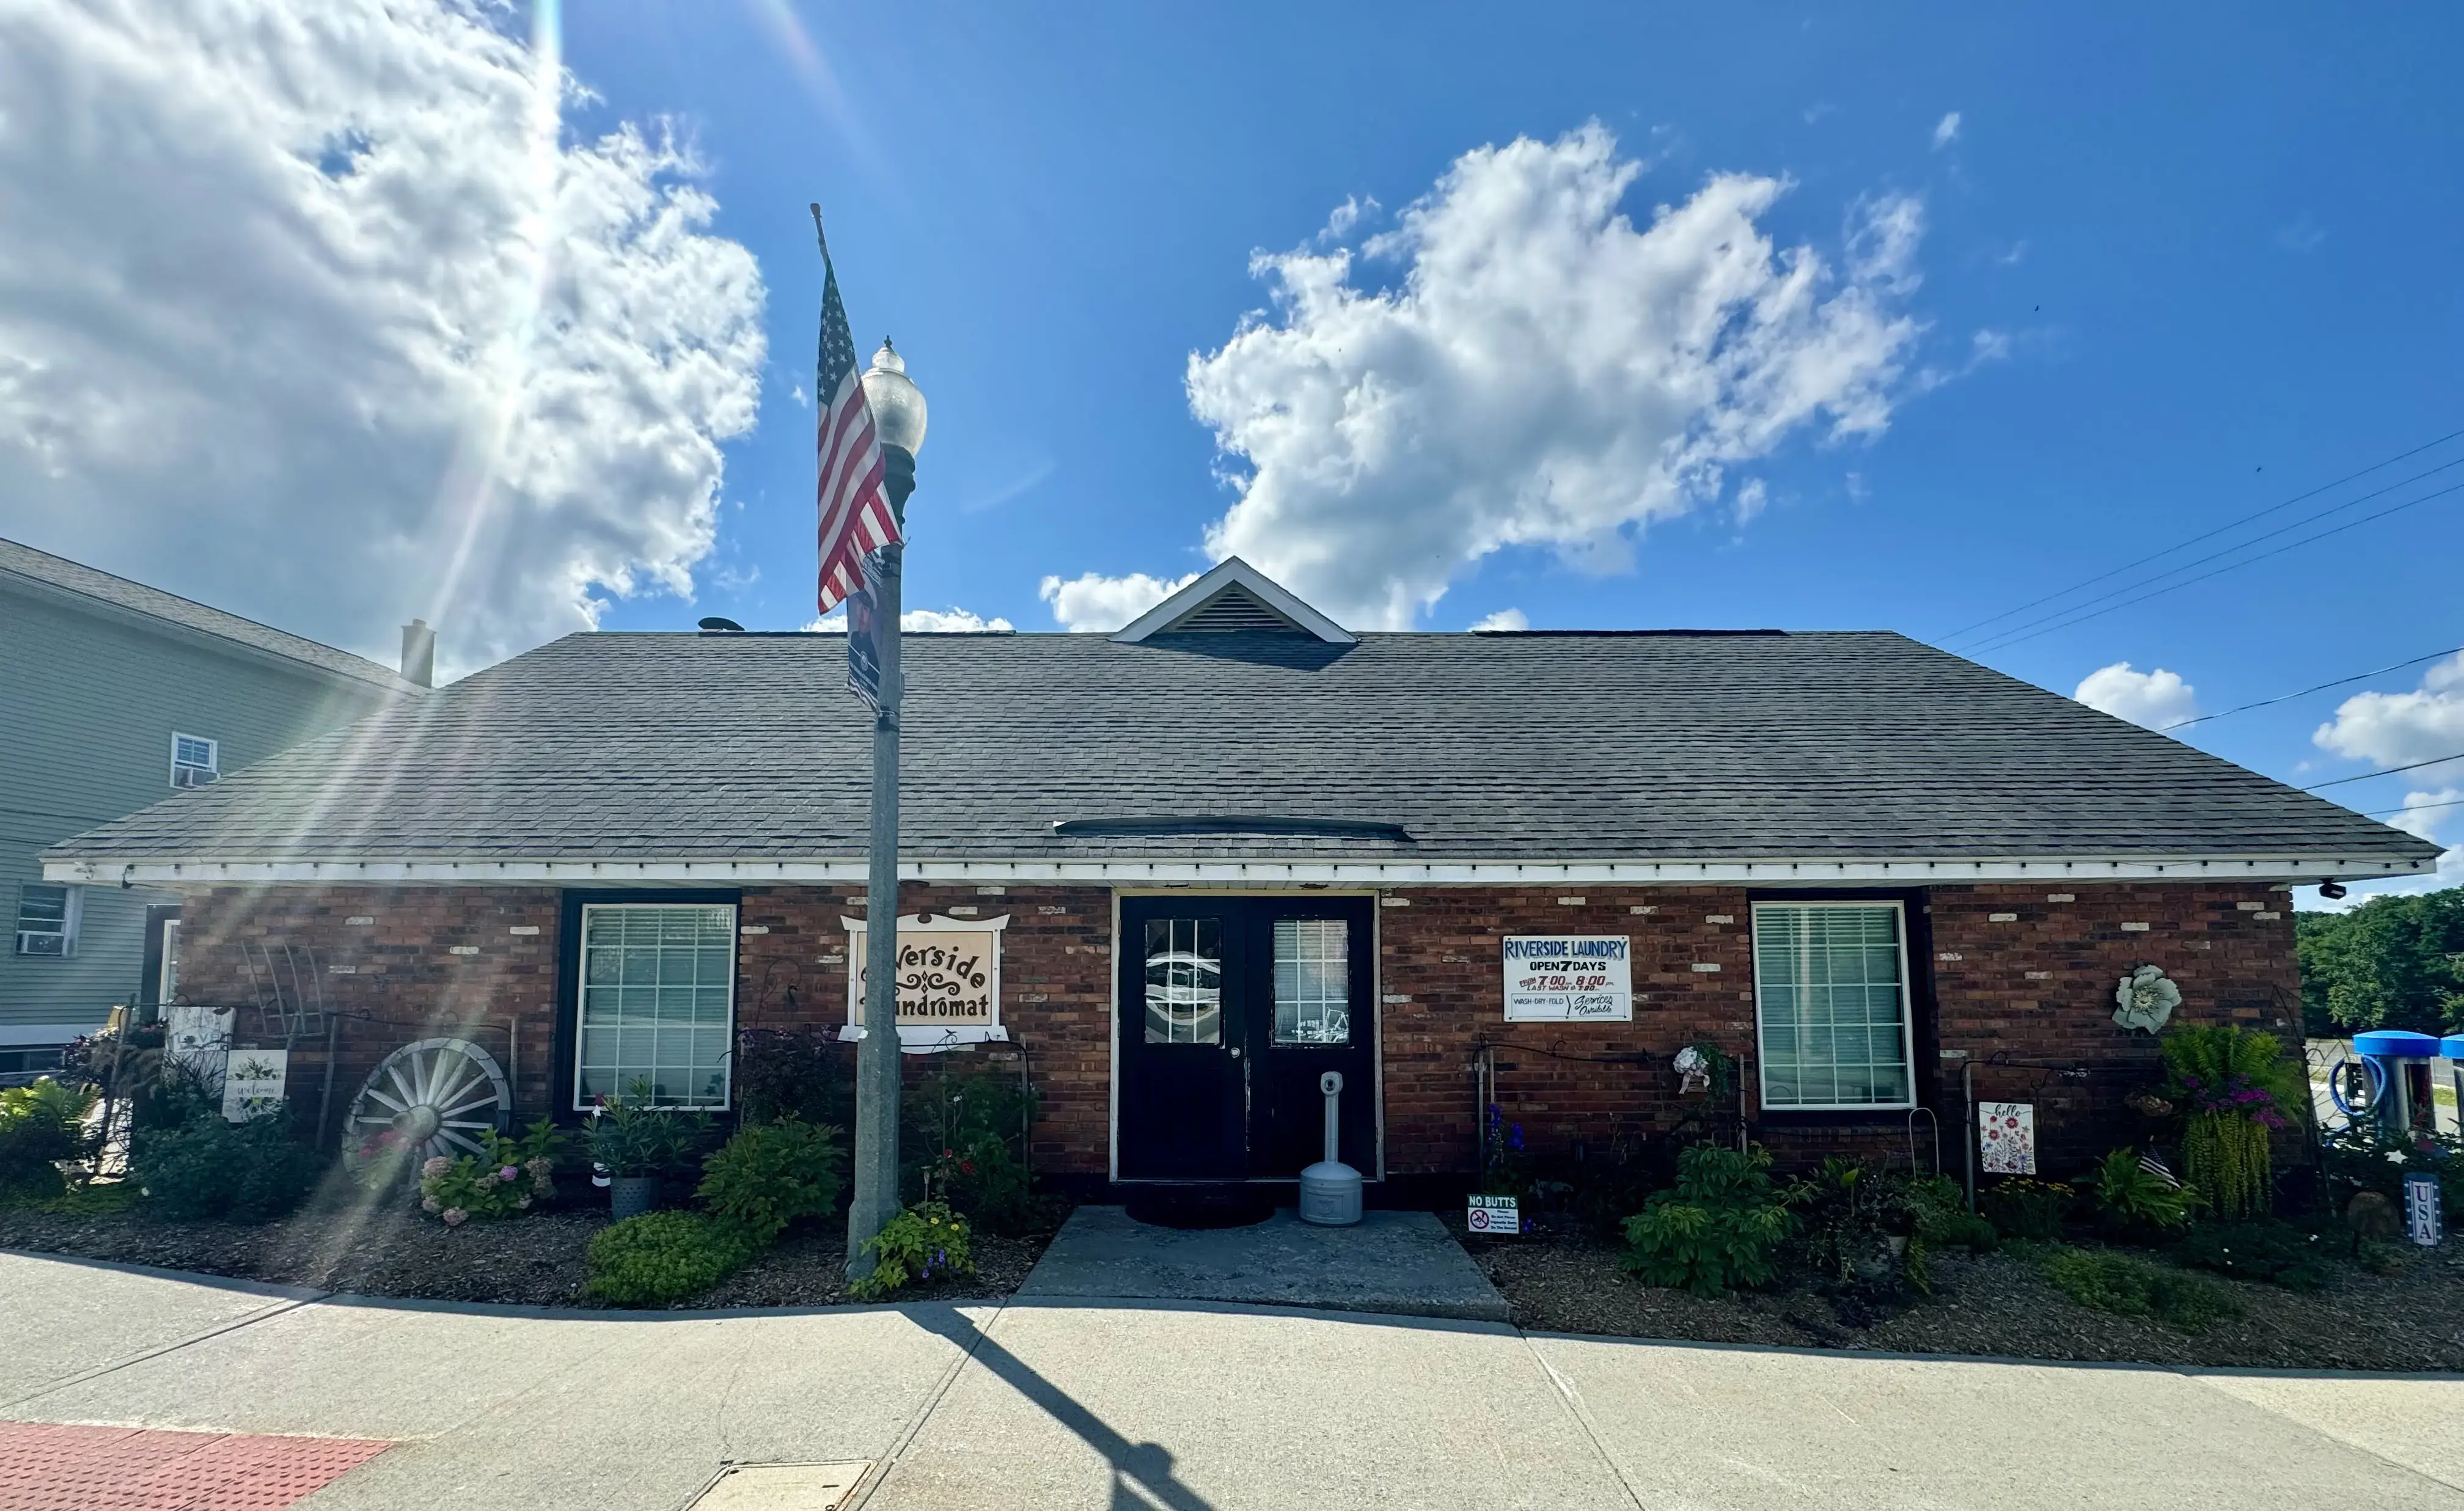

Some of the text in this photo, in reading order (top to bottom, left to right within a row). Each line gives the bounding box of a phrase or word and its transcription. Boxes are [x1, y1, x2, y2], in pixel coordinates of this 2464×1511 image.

[1505, 940, 1628, 960] RIVERSIDE LAUNDRY
[1530, 961, 1607, 971] OPEN 7 DAYS
[1574, 995, 1613, 1010] Services
[1995, 1103, 2021, 1118] hello
[1469, 1196, 1516, 1207] NO BUTTS
[2414, 1185, 2433, 1240] USA
